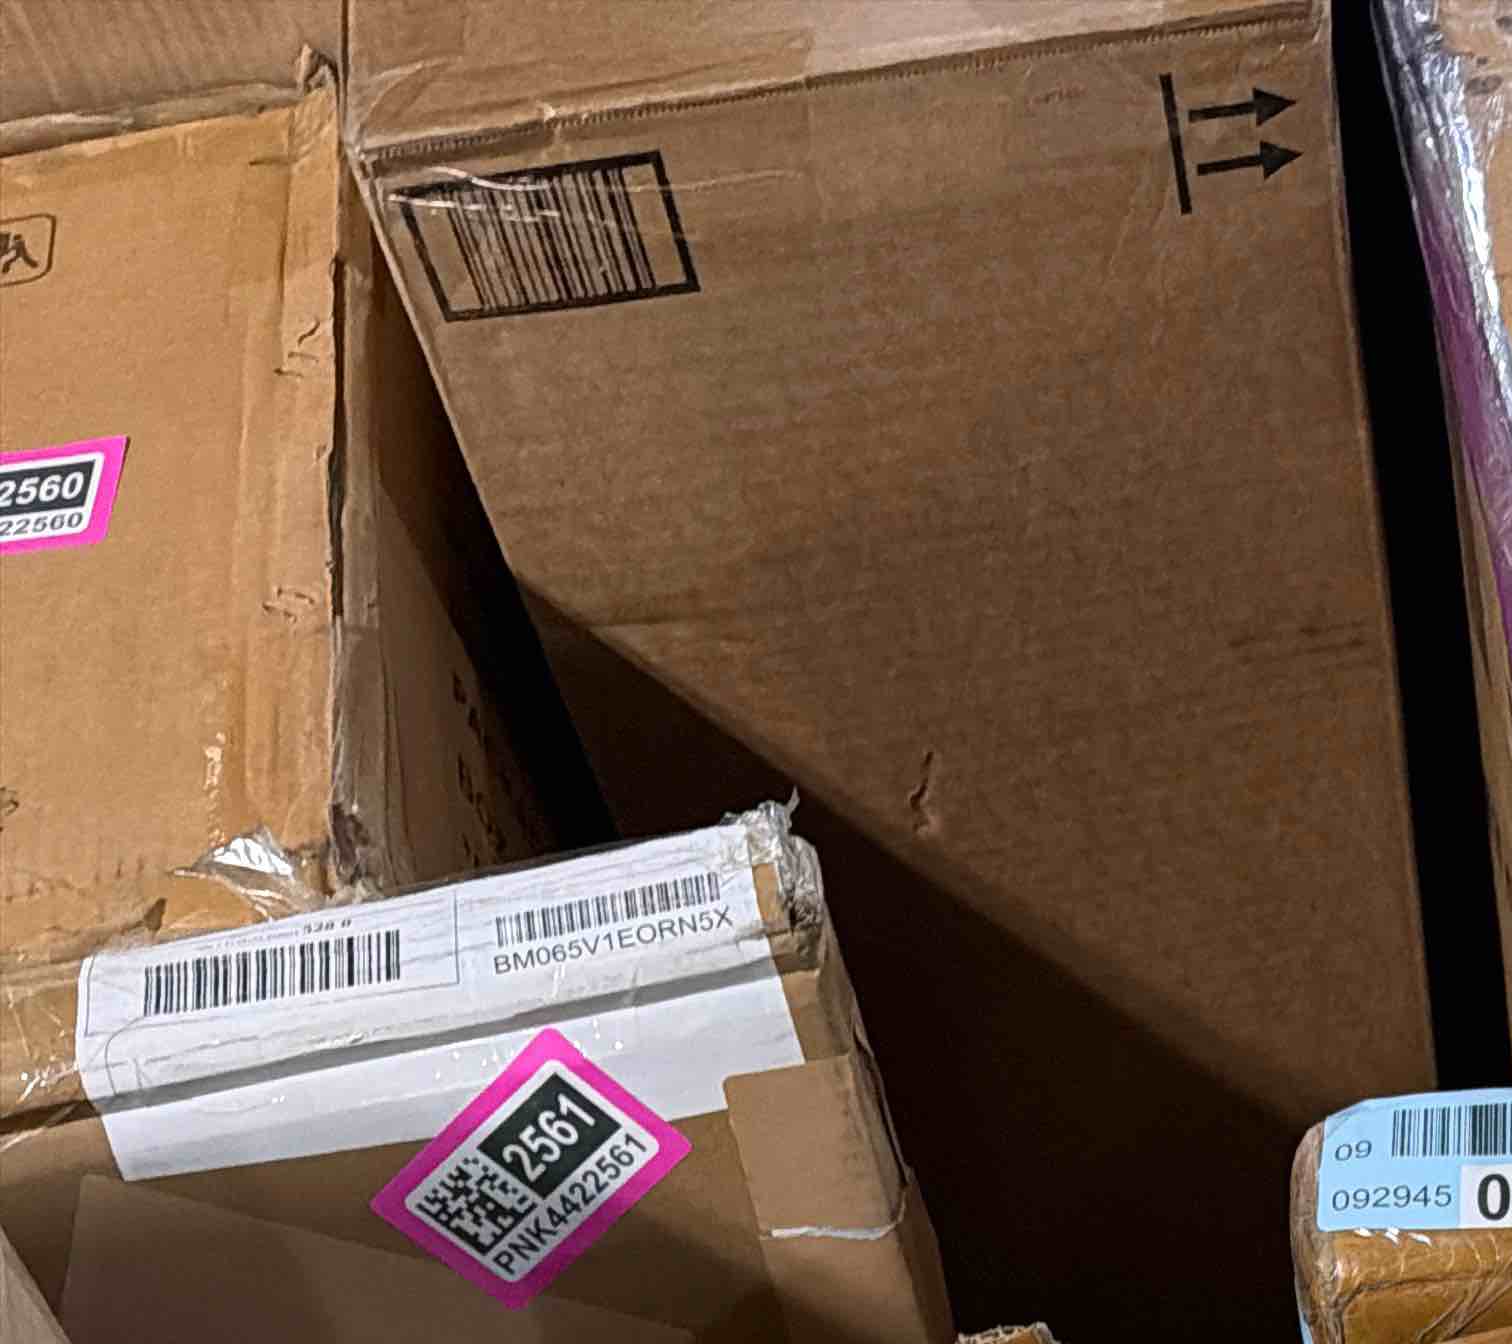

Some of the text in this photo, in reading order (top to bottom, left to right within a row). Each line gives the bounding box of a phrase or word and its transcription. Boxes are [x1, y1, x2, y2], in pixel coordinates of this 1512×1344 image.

[502, 1092, 597, 1183] 2561
[1334, 1139, 1373, 1161] 09
[491, 1132, 648, 1276] PNK4422561
[1331, 1184, 1453, 1212] 092945
